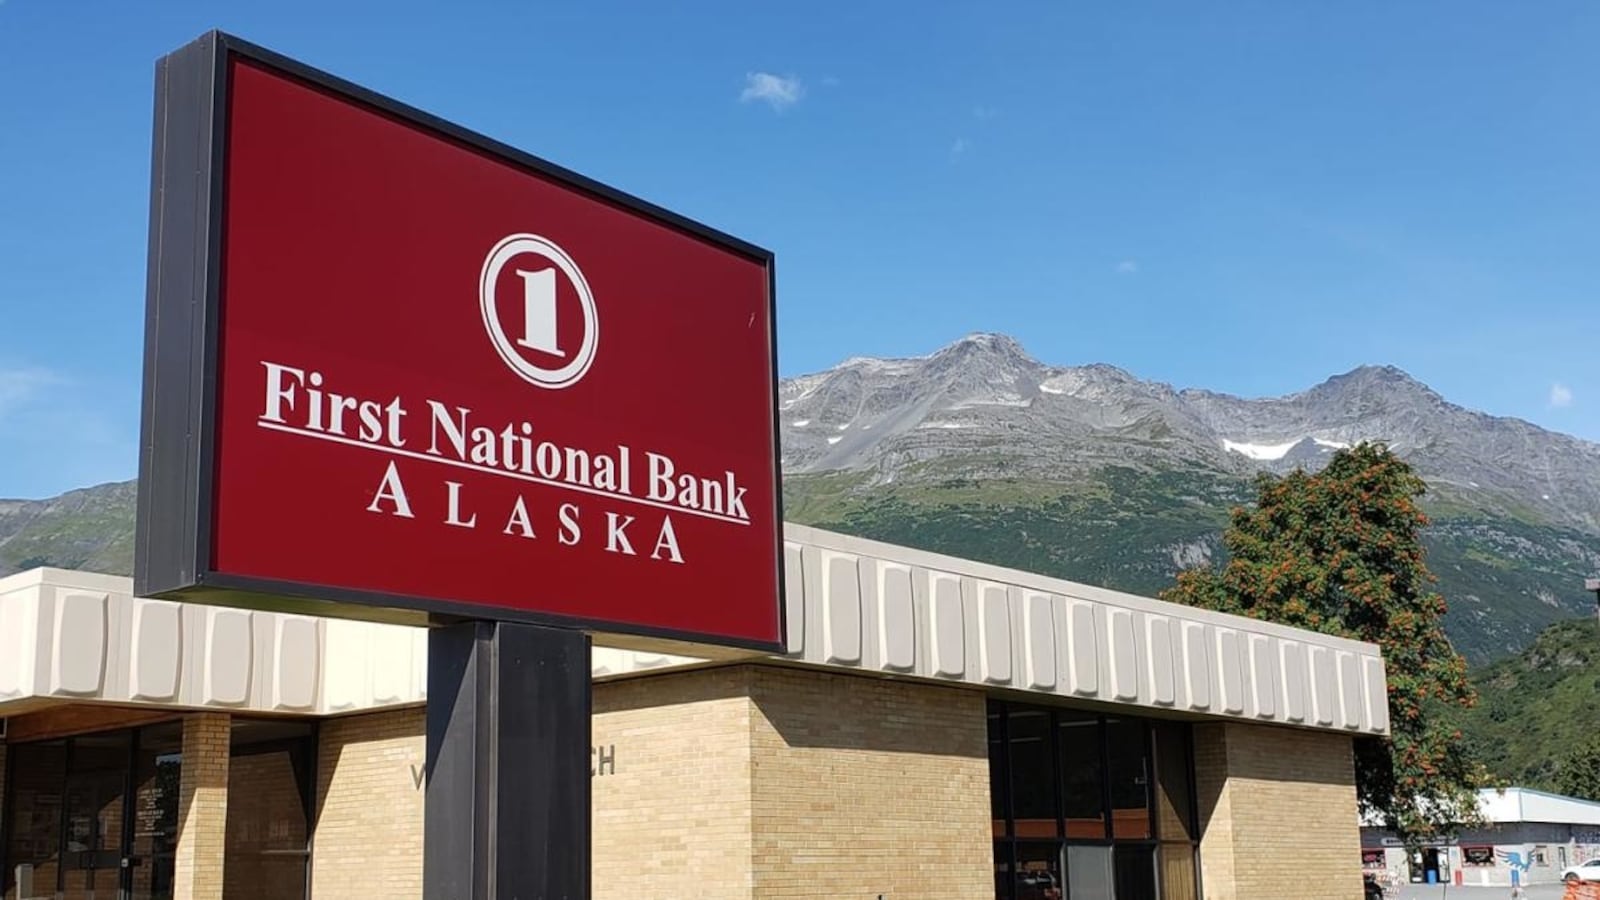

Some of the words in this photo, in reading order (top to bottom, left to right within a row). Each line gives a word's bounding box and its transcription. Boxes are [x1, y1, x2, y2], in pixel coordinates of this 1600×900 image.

[516, 267, 566, 358] 1
[259, 360, 407, 447] First
[426, 399, 631, 495] National
[645, 451, 750, 520] Bank
[366, 460, 685, 564] ALASKA
